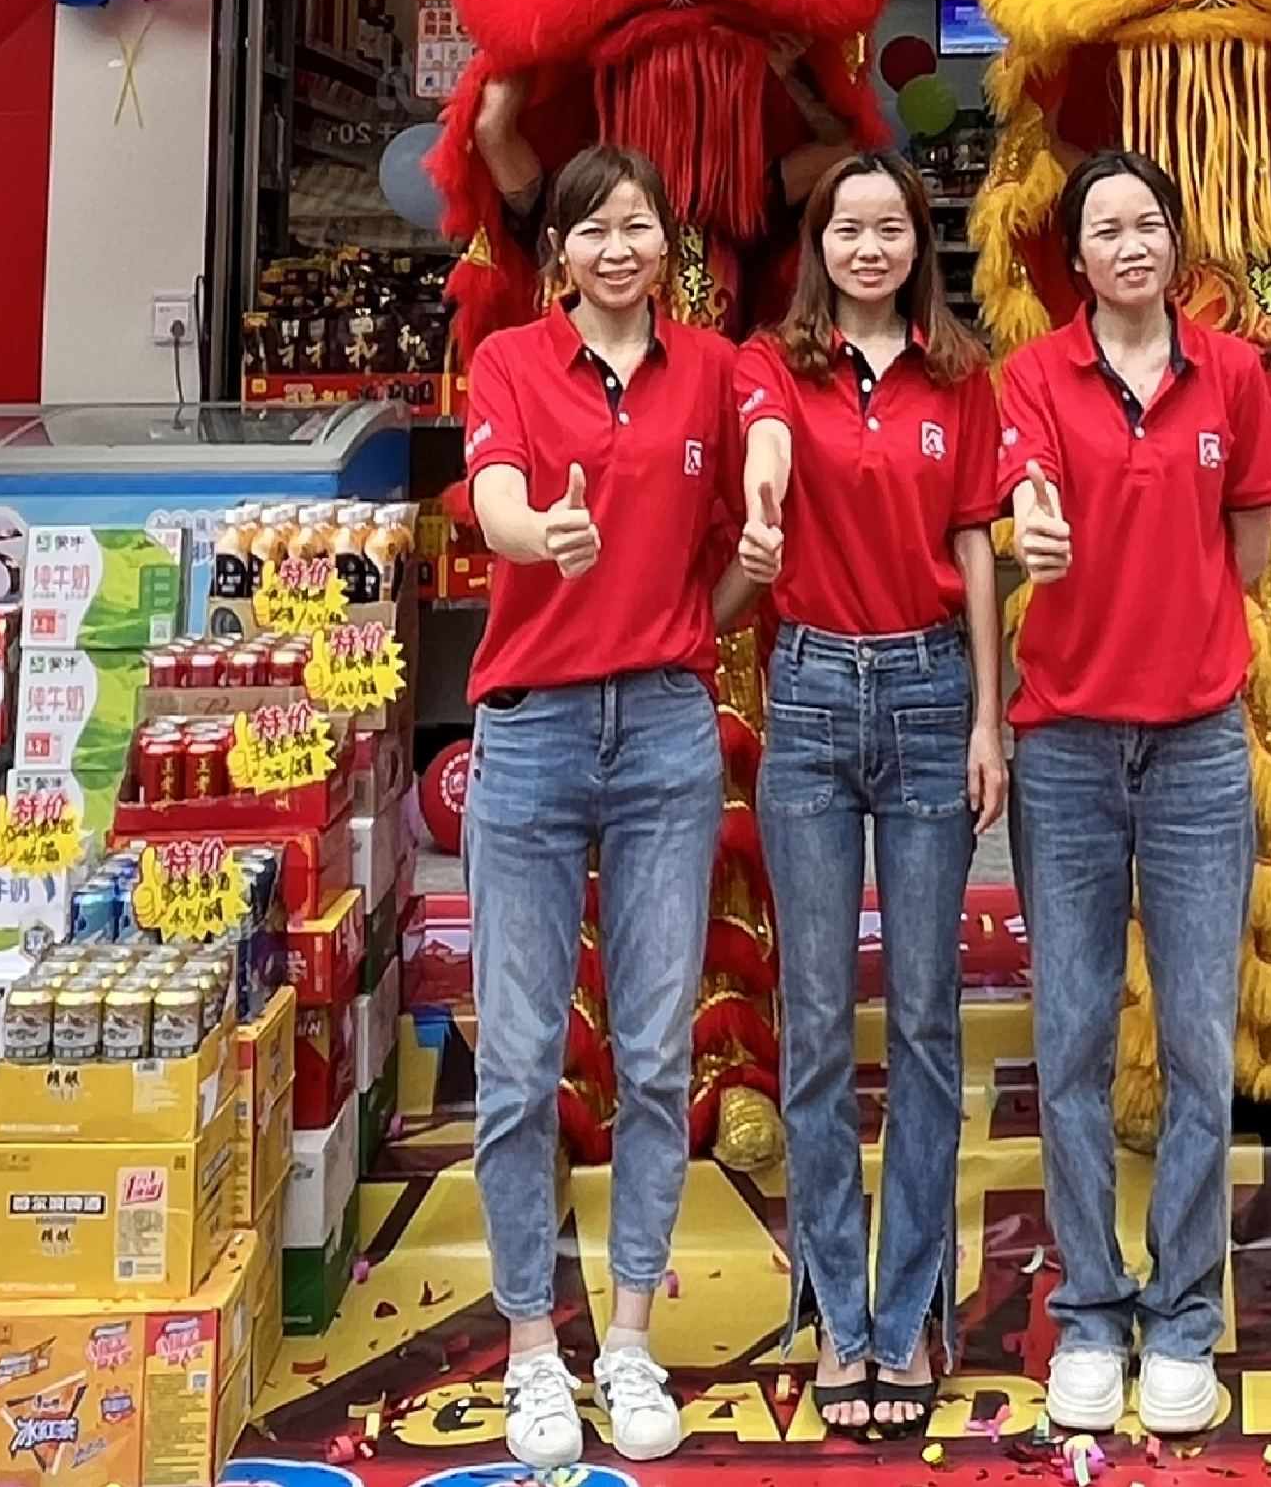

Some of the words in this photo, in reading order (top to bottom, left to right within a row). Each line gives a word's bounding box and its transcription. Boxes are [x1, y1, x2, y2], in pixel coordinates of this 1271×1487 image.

[281, 558, 331, 587] 特价
[331, 621, 387, 654] 特价
[254, 699, 314, 739] 特价
[15, 790, 68, 822] 特价
[163, 836, 225, 877] 特价
